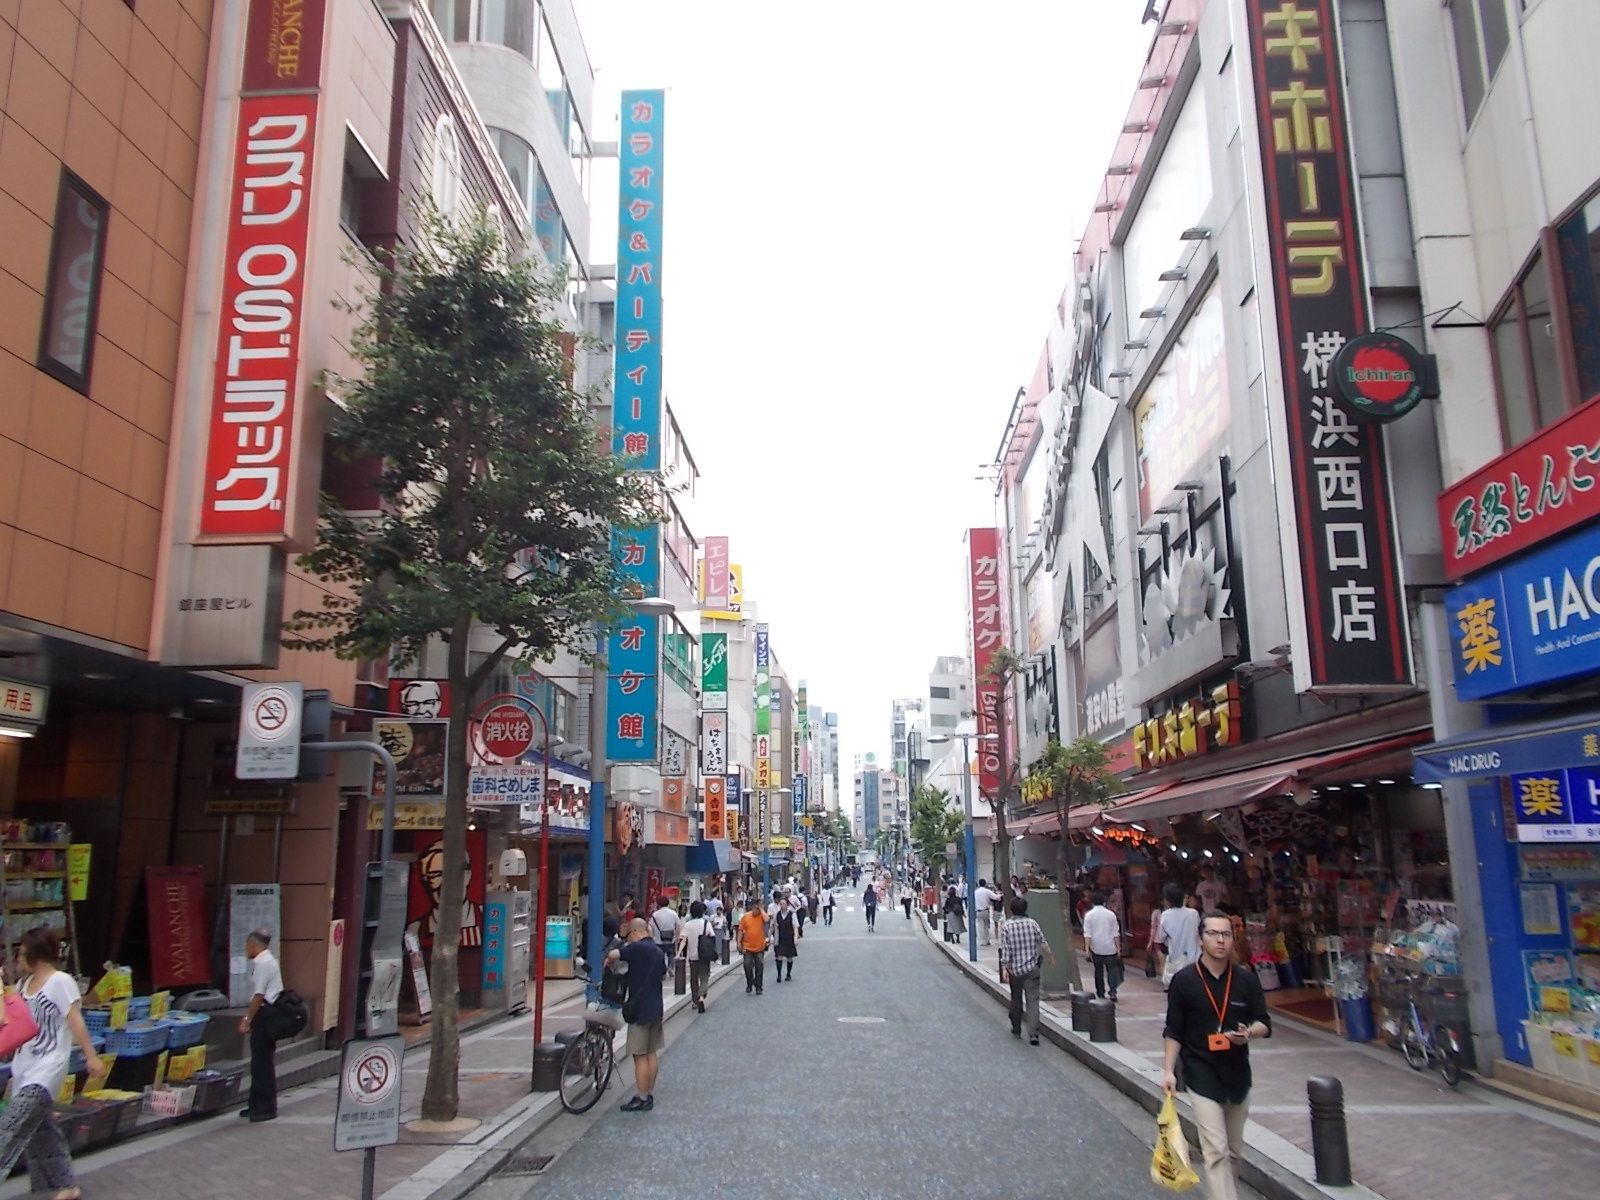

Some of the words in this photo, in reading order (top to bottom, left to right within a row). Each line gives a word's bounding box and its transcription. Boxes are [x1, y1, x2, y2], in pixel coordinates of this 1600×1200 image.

[623, 102, 653, 454] カラオケ&パーティー館
[1347, 366, 1416, 384] Ichiran
[1302, 331, 1377, 642] 横浜西口店
[707, 545, 726, 595] エピレ
[178, 597, 253, 613] 銀座屋ビル
[975, 555, 1001, 650] カラオケ
[618, 543, 646, 741] カオケ館
[1456, 598, 1503, 676] 薬
[486, 721, 530, 742] 消火栓
[984, 727, 1001, 772] EHO
[759, 760, 768, 787] メガネ
[1450, 756, 1471, 773] HAC
[1471, 751, 1501, 772] DRUG
[709, 797, 720, 835] 吉野家
[1518, 777, 1564, 816] 薬
